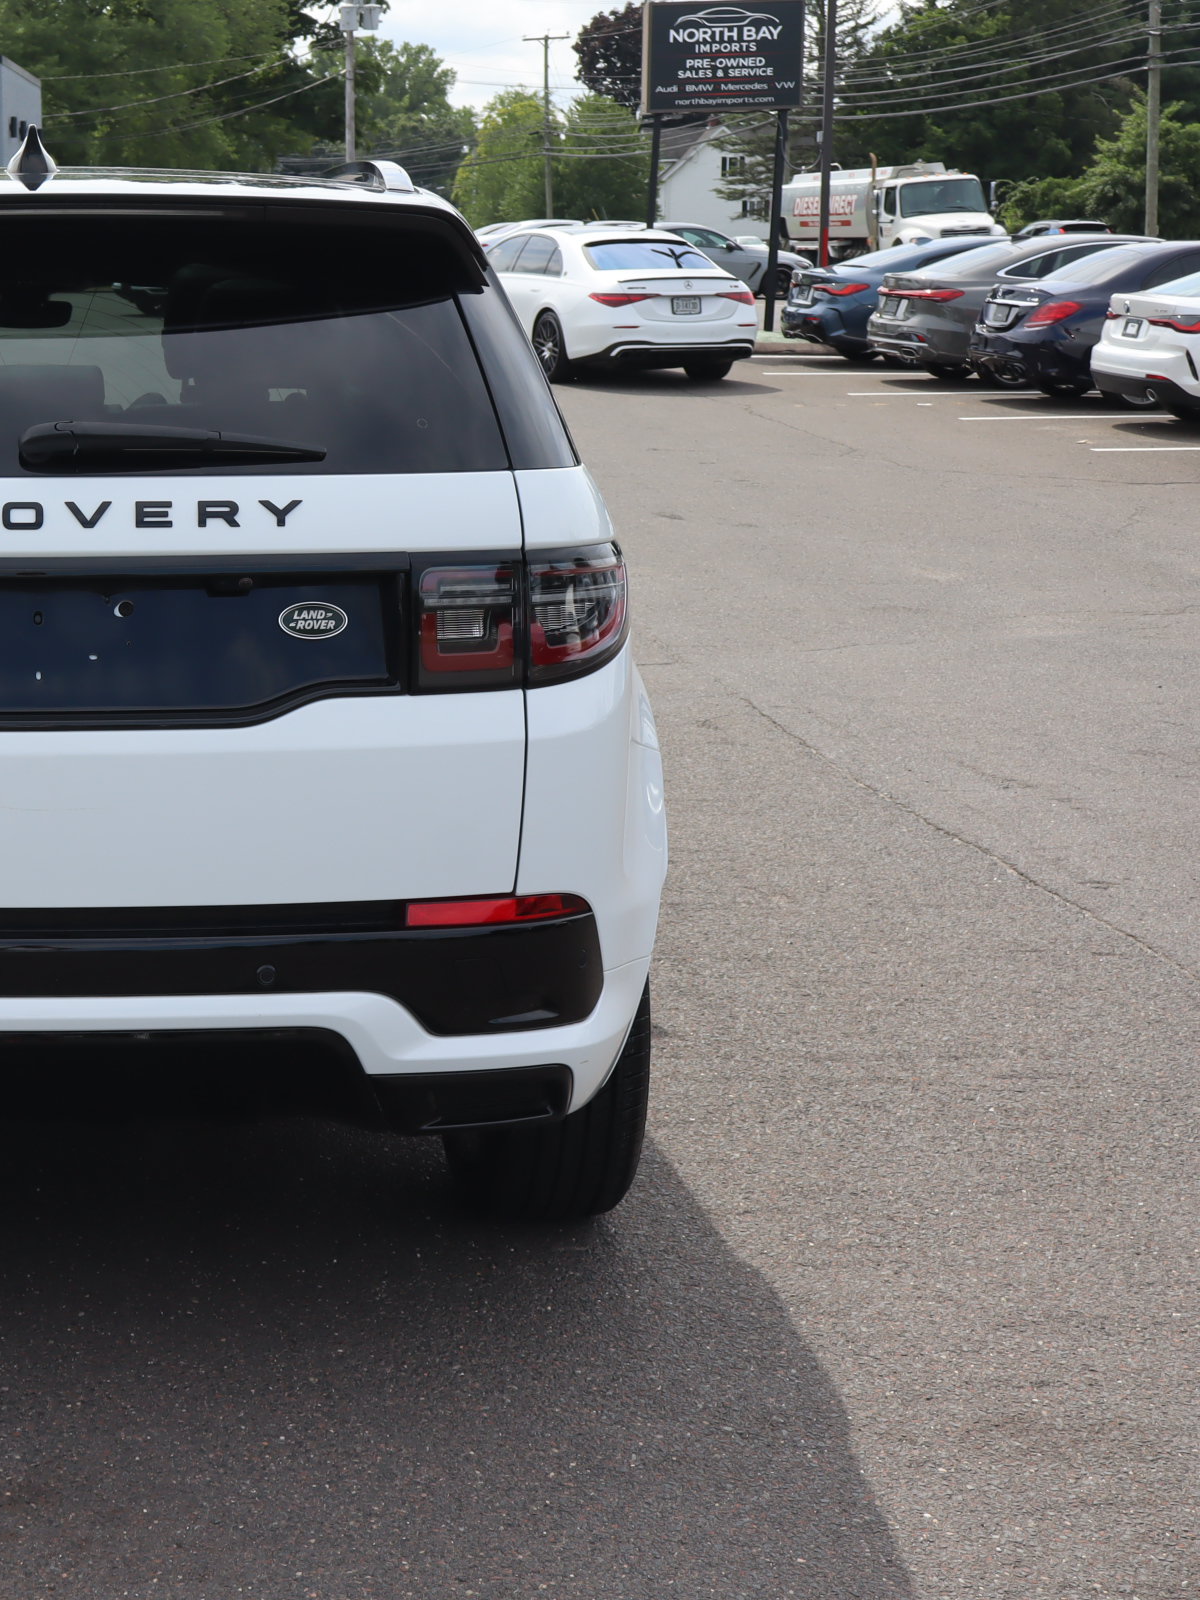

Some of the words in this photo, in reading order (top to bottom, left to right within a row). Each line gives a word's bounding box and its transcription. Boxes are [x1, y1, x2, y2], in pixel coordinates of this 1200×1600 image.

[669, 27, 738, 43] NORTH
[743, 25, 783, 41] BAY
[695, 42, 757, 53] IMPORTS
[686, 57, 766, 68] PRE-OWNED
[677, 69, 712, 78] SALES
[716, 69, 724, 77] &
[728, 67, 774, 76] SERVICE
[655, 85, 678, 93] Audi
[685, 84, 714, 92] BMW
[720, 82, 768, 91] Mercedes
[774, 81, 796, 89] VW
[675, 96, 775, 106] northbayimports.com
[293, 610, 326, 620] LAND
[296, 620, 336, 630] ROVER
